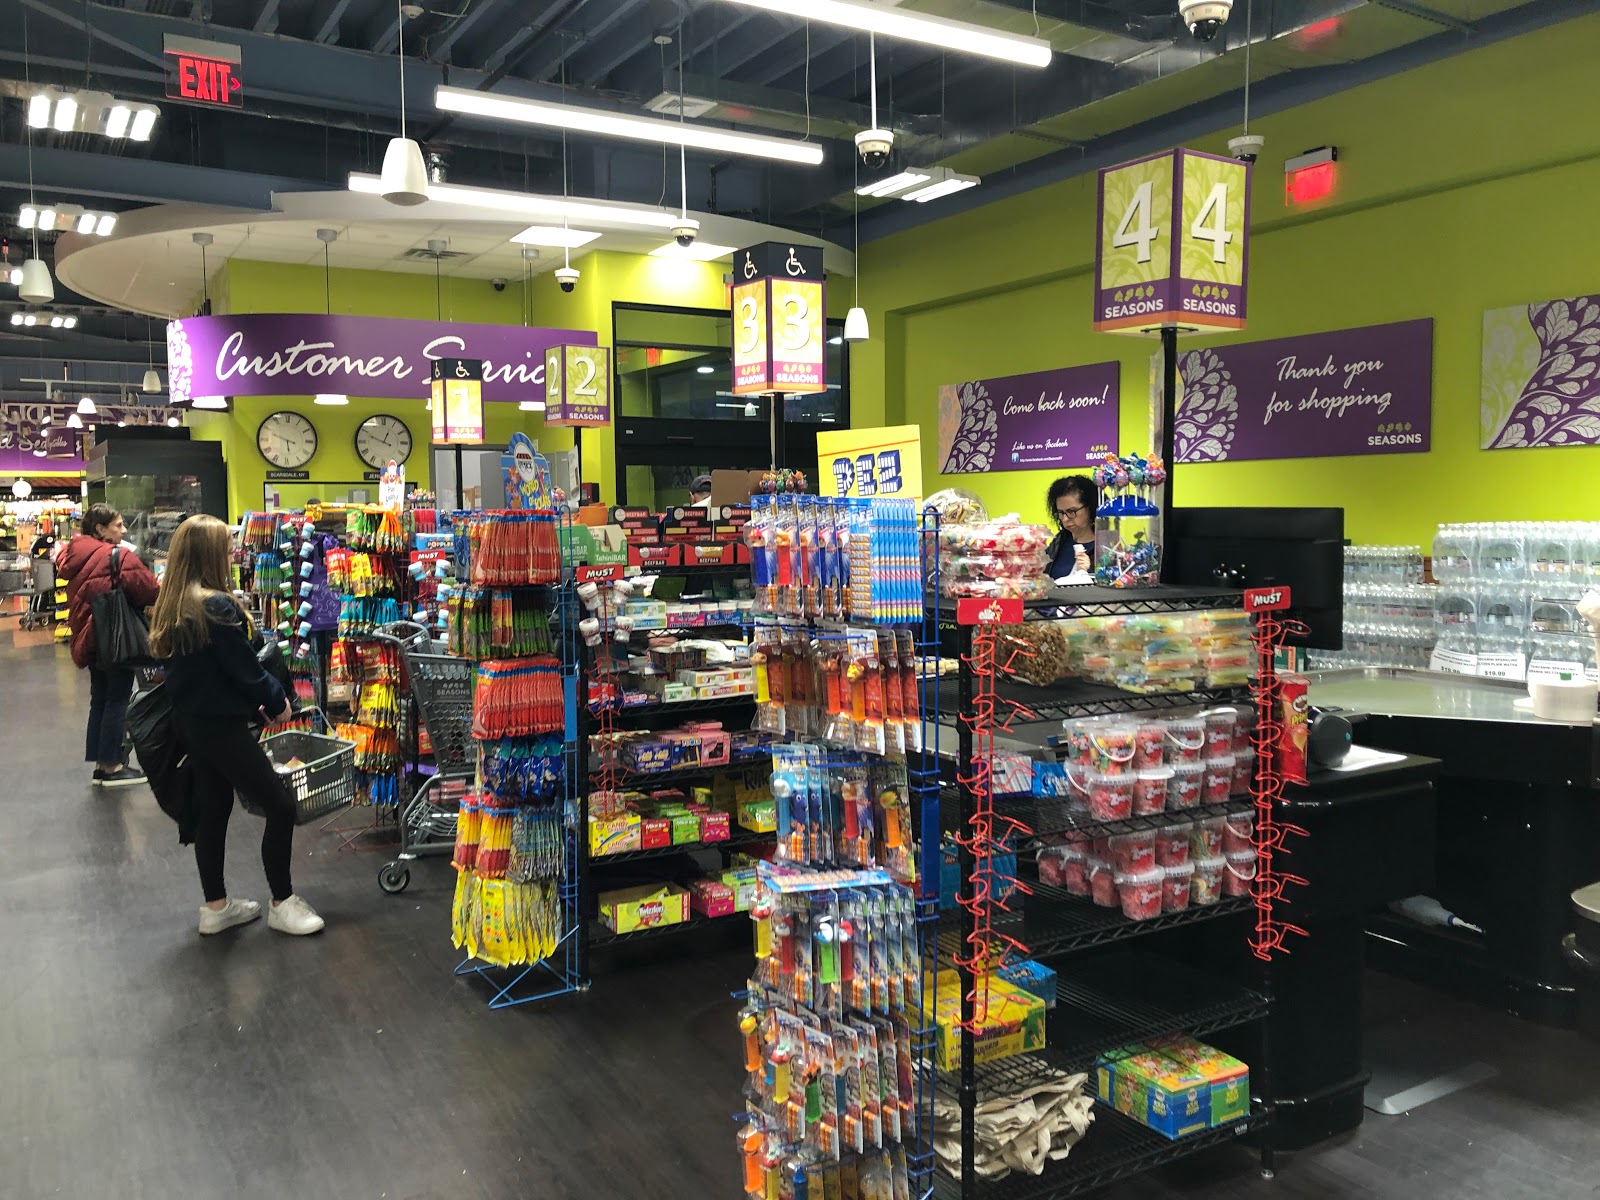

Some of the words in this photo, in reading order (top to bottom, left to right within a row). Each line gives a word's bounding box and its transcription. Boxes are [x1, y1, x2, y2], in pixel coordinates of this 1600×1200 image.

[179, 57, 231, 103] EXIT
[1113, 181, 1159, 264] 4
[1191, 182, 1233, 264] 4
[784, 294, 811, 351] 3
[1104, 298, 1164, 319] SEASONS
[1183, 298, 1237, 316] SEASONS
[741, 296, 760, 354] 3
[215, 331, 413, 380] Customer
[1276, 355, 1337, 382] Thank
[1344, 360, 1385, 389] you
[548, 356, 559, 397] 2
[574, 355, 599, 397] 2
[737, 374, 766, 386] SEASONS
[776, 373, 819, 384] SEASONS
[569, 412, 605, 420] SEASONS
[1003, 395, 1035, 416] Come
[1038, 391, 1066, 412] back
[1069, 384, 1109, 409] soon!
[1264, 391, 1293, 425] for
[1298, 388, 1392, 419] shopping
[1012, 441, 1025, 451] Like
[1367, 433, 1423, 446] SEASONS
[832, 449, 903, 498] PEZ
[418, 552, 439, 560] MUST
[586, 568, 615, 579] MUST
[1253, 593, 1282, 606] MUST
